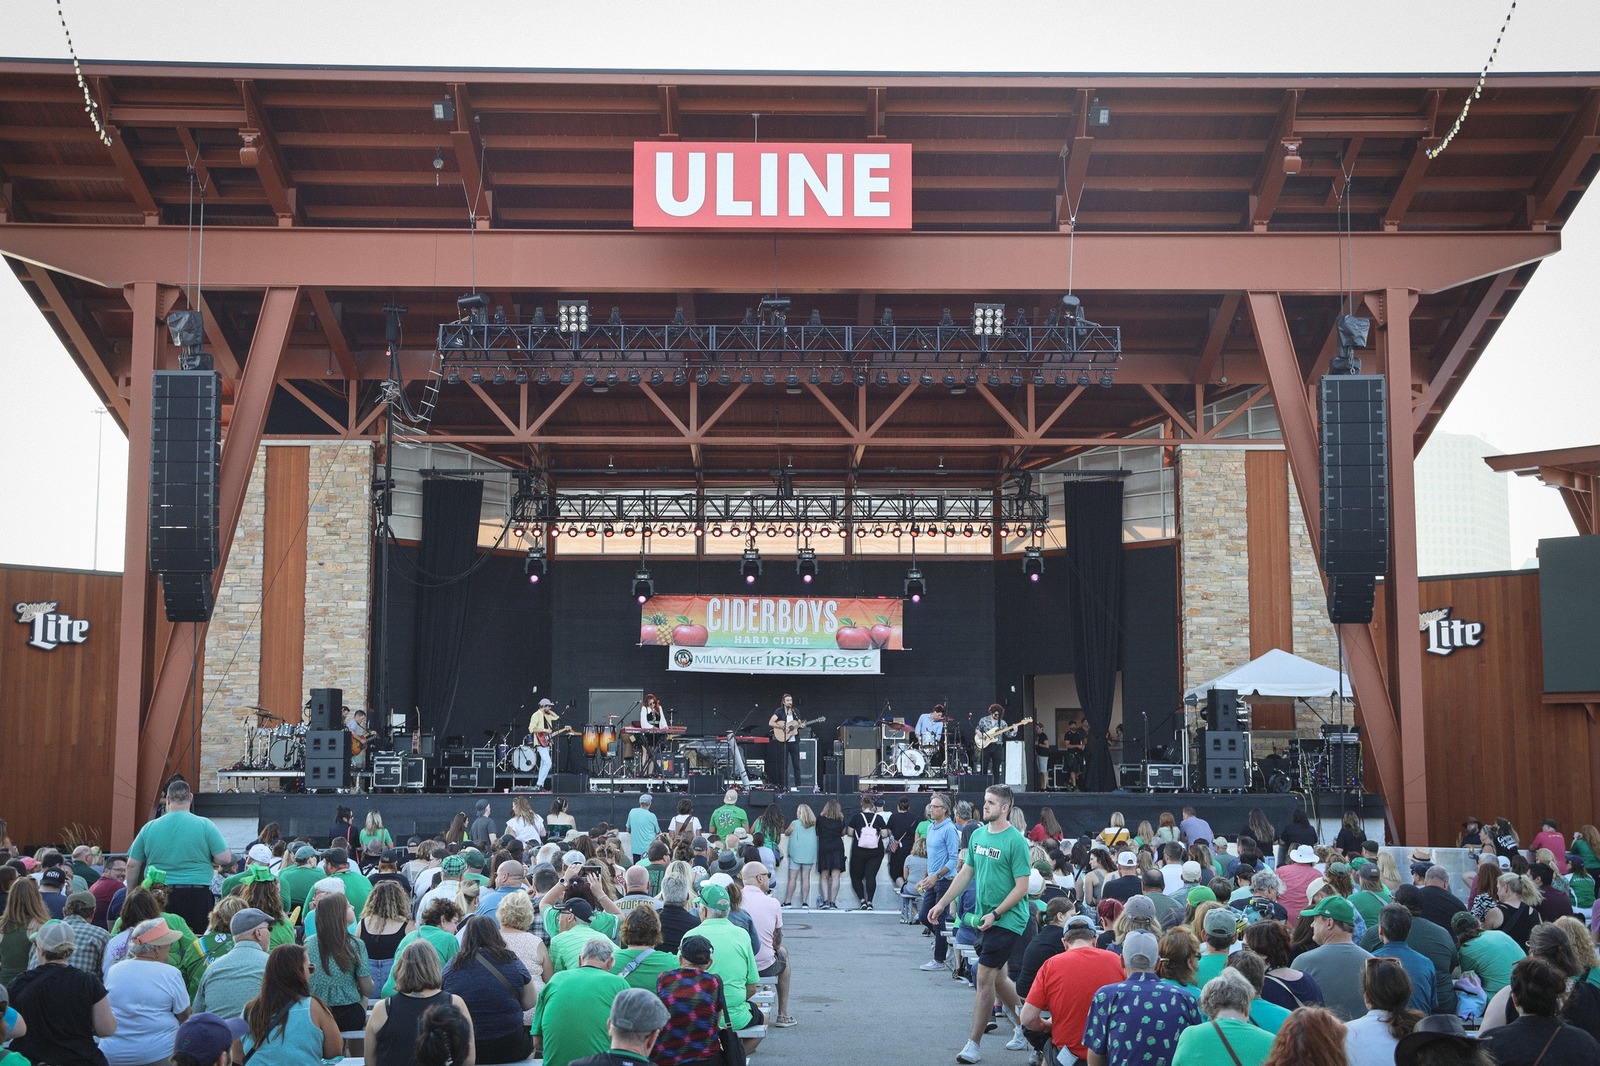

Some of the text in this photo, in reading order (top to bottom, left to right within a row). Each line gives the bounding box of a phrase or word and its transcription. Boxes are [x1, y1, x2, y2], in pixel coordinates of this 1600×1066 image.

[655, 152, 891, 216] ULINE
[30, 612, 89, 650] Lite
[706, 597, 838, 634] CIDERBOYS
[734, 635, 809, 646] HARD CIDER
[1426, 620, 1481, 655] Lite
[694, 654, 763, 665] MILWAUKEE
